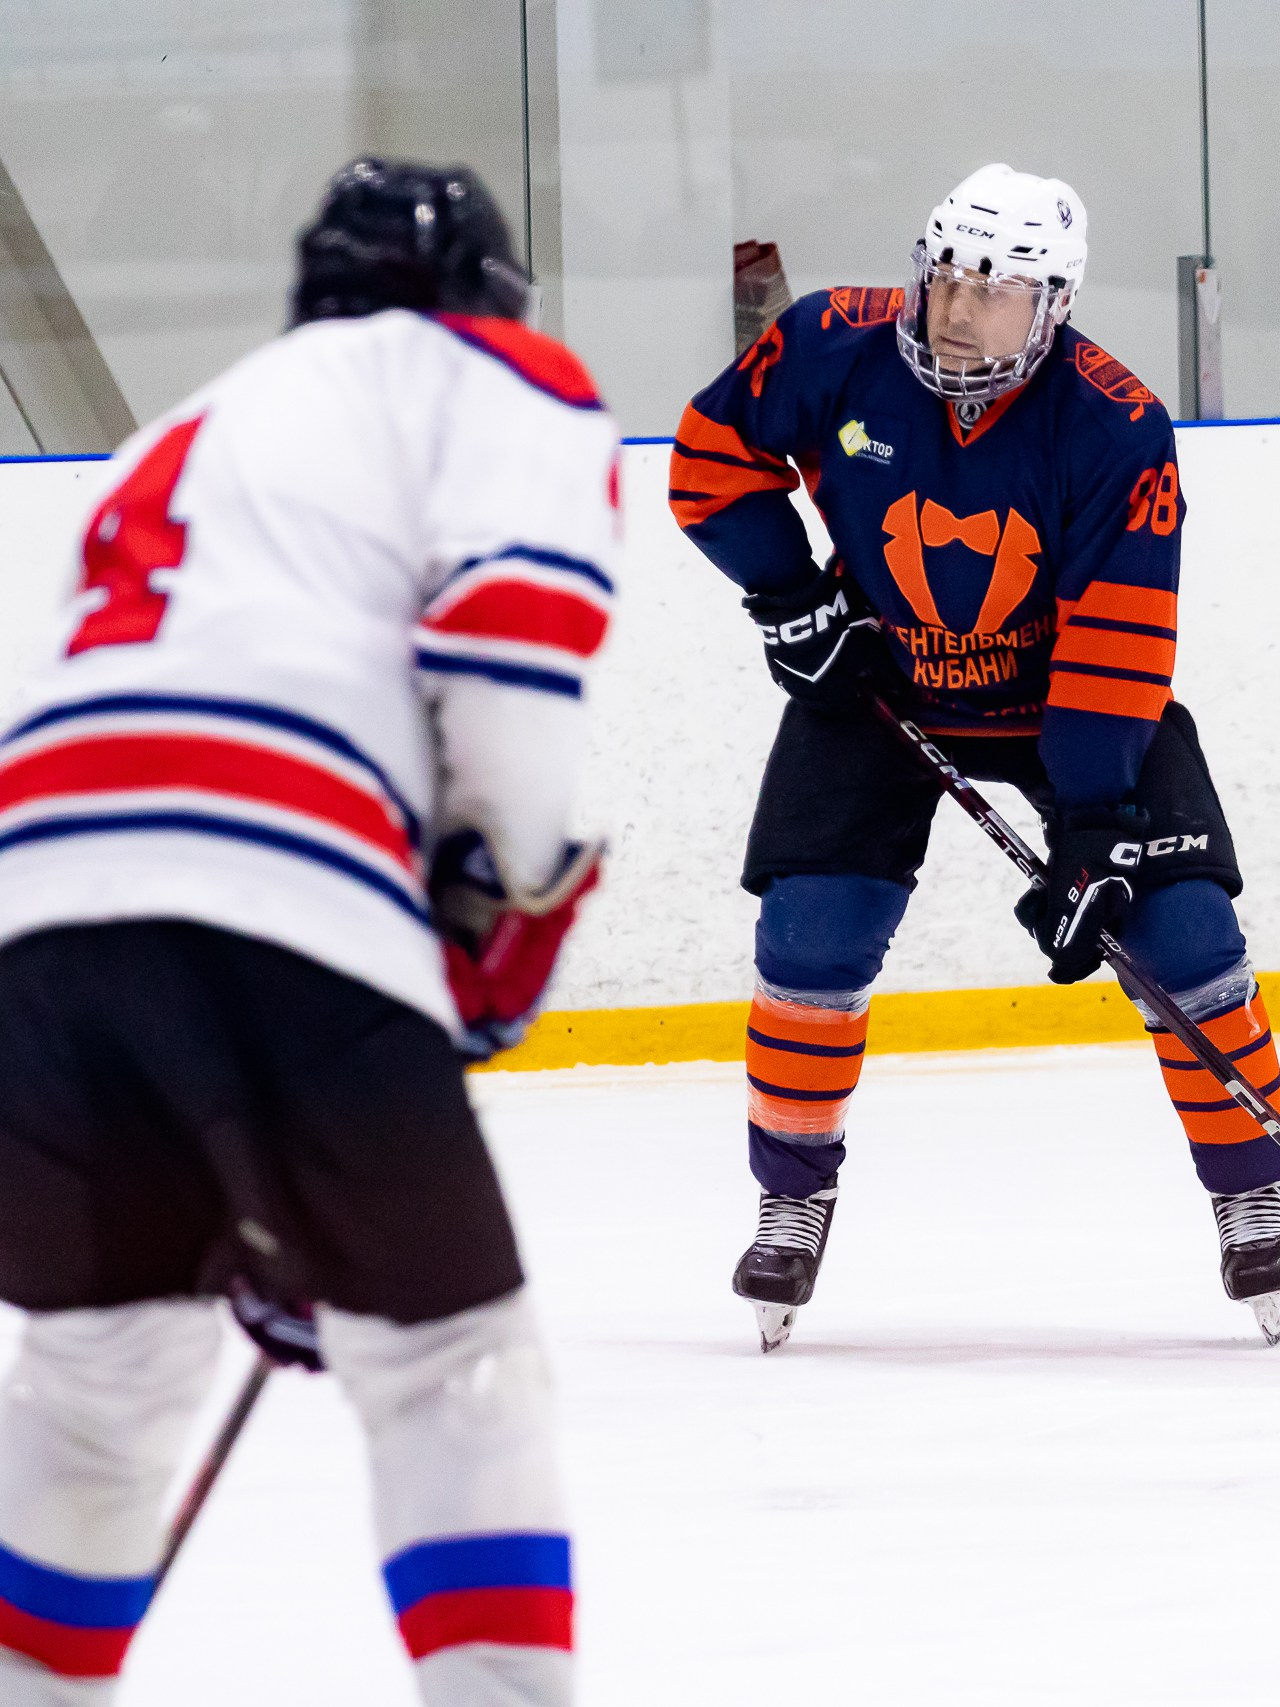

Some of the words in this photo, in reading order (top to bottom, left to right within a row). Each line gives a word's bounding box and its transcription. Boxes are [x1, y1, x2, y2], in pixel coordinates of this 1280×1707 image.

[956, 223, 996, 240] CCM
[862, 439, 894, 458] КТОР
[756, 588, 850, 646] CCM
[884, 612, 1056, 657] ЕНТЕЛЬМЕН
[913, 649, 1019, 690] КУБАНИ
[900, 720, 972, 790] CCM
[1052, 914, 1069, 948] CCM
